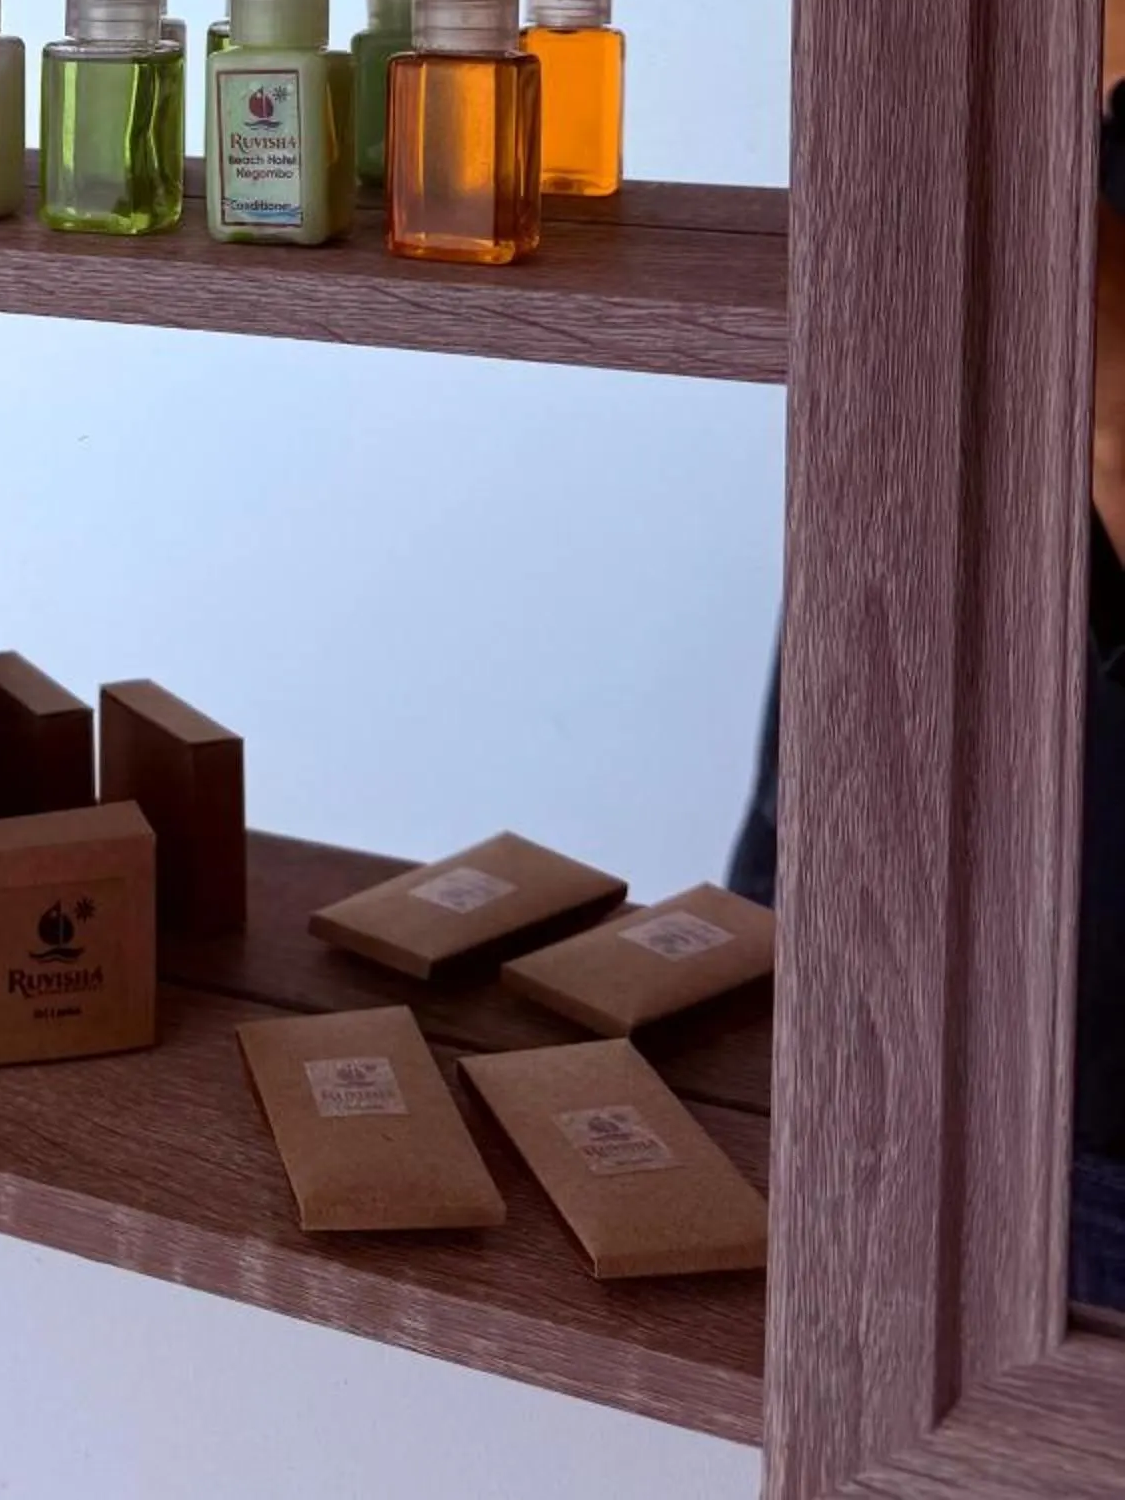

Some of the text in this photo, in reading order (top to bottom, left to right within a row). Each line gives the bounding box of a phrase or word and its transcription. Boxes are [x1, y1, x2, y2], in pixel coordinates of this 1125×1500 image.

[230, 131, 298, 153] RUVISHA
[228, 153, 297, 165] Beach Hotel
[236, 167, 294, 181] Negombo
[8, 964, 104, 999] RUVISHA
